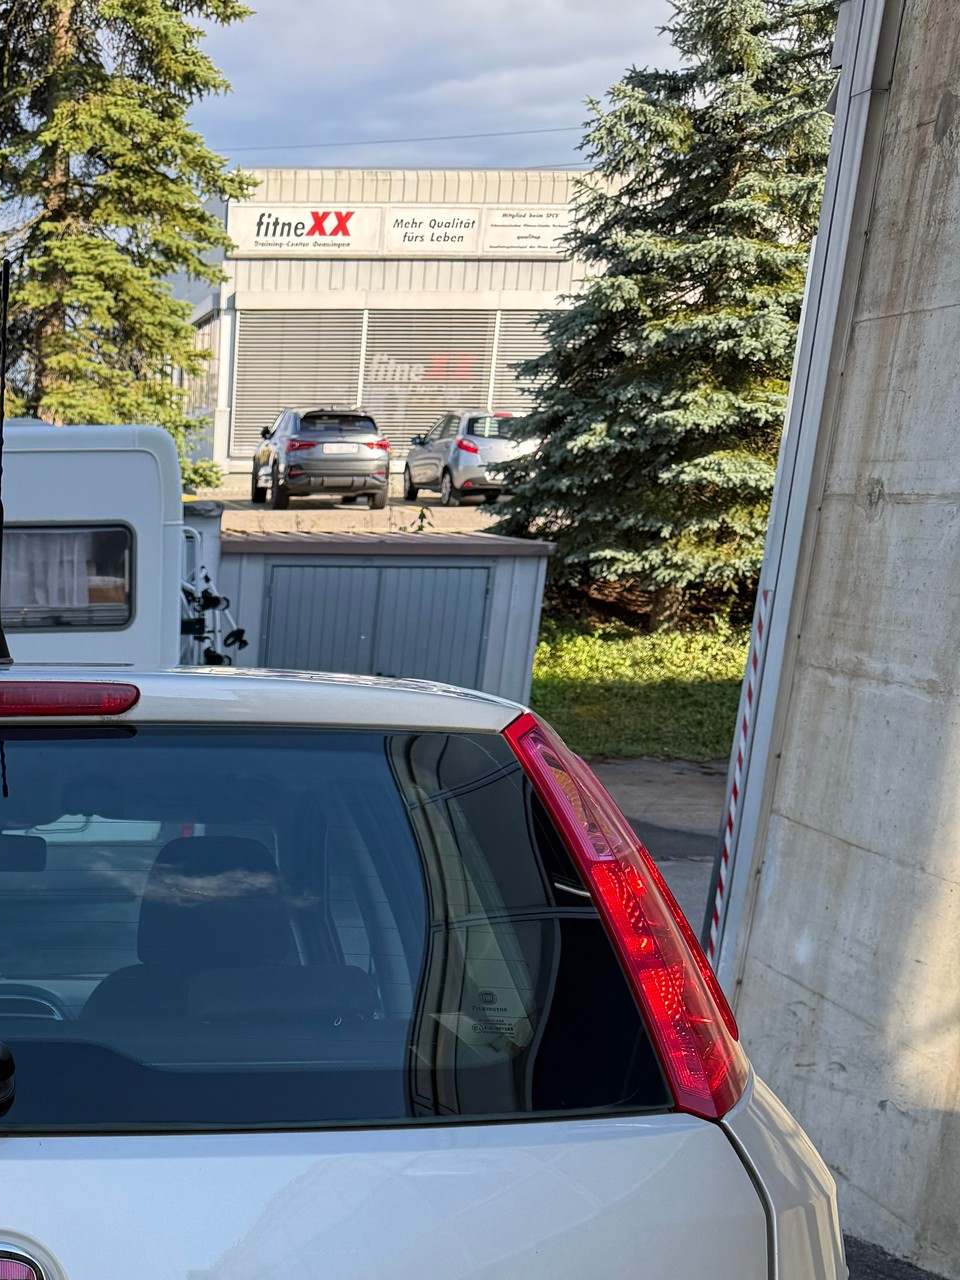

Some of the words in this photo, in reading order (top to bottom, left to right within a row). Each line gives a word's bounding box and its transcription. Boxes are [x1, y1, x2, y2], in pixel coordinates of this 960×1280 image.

[255, 211, 355, 237] fitneXX
[393, 219, 423, 229] Mehr
[428, 218, 476, 229] Qualität
[402, 231, 425, 243] fürs
[430, 232, 464, 242] Leben
